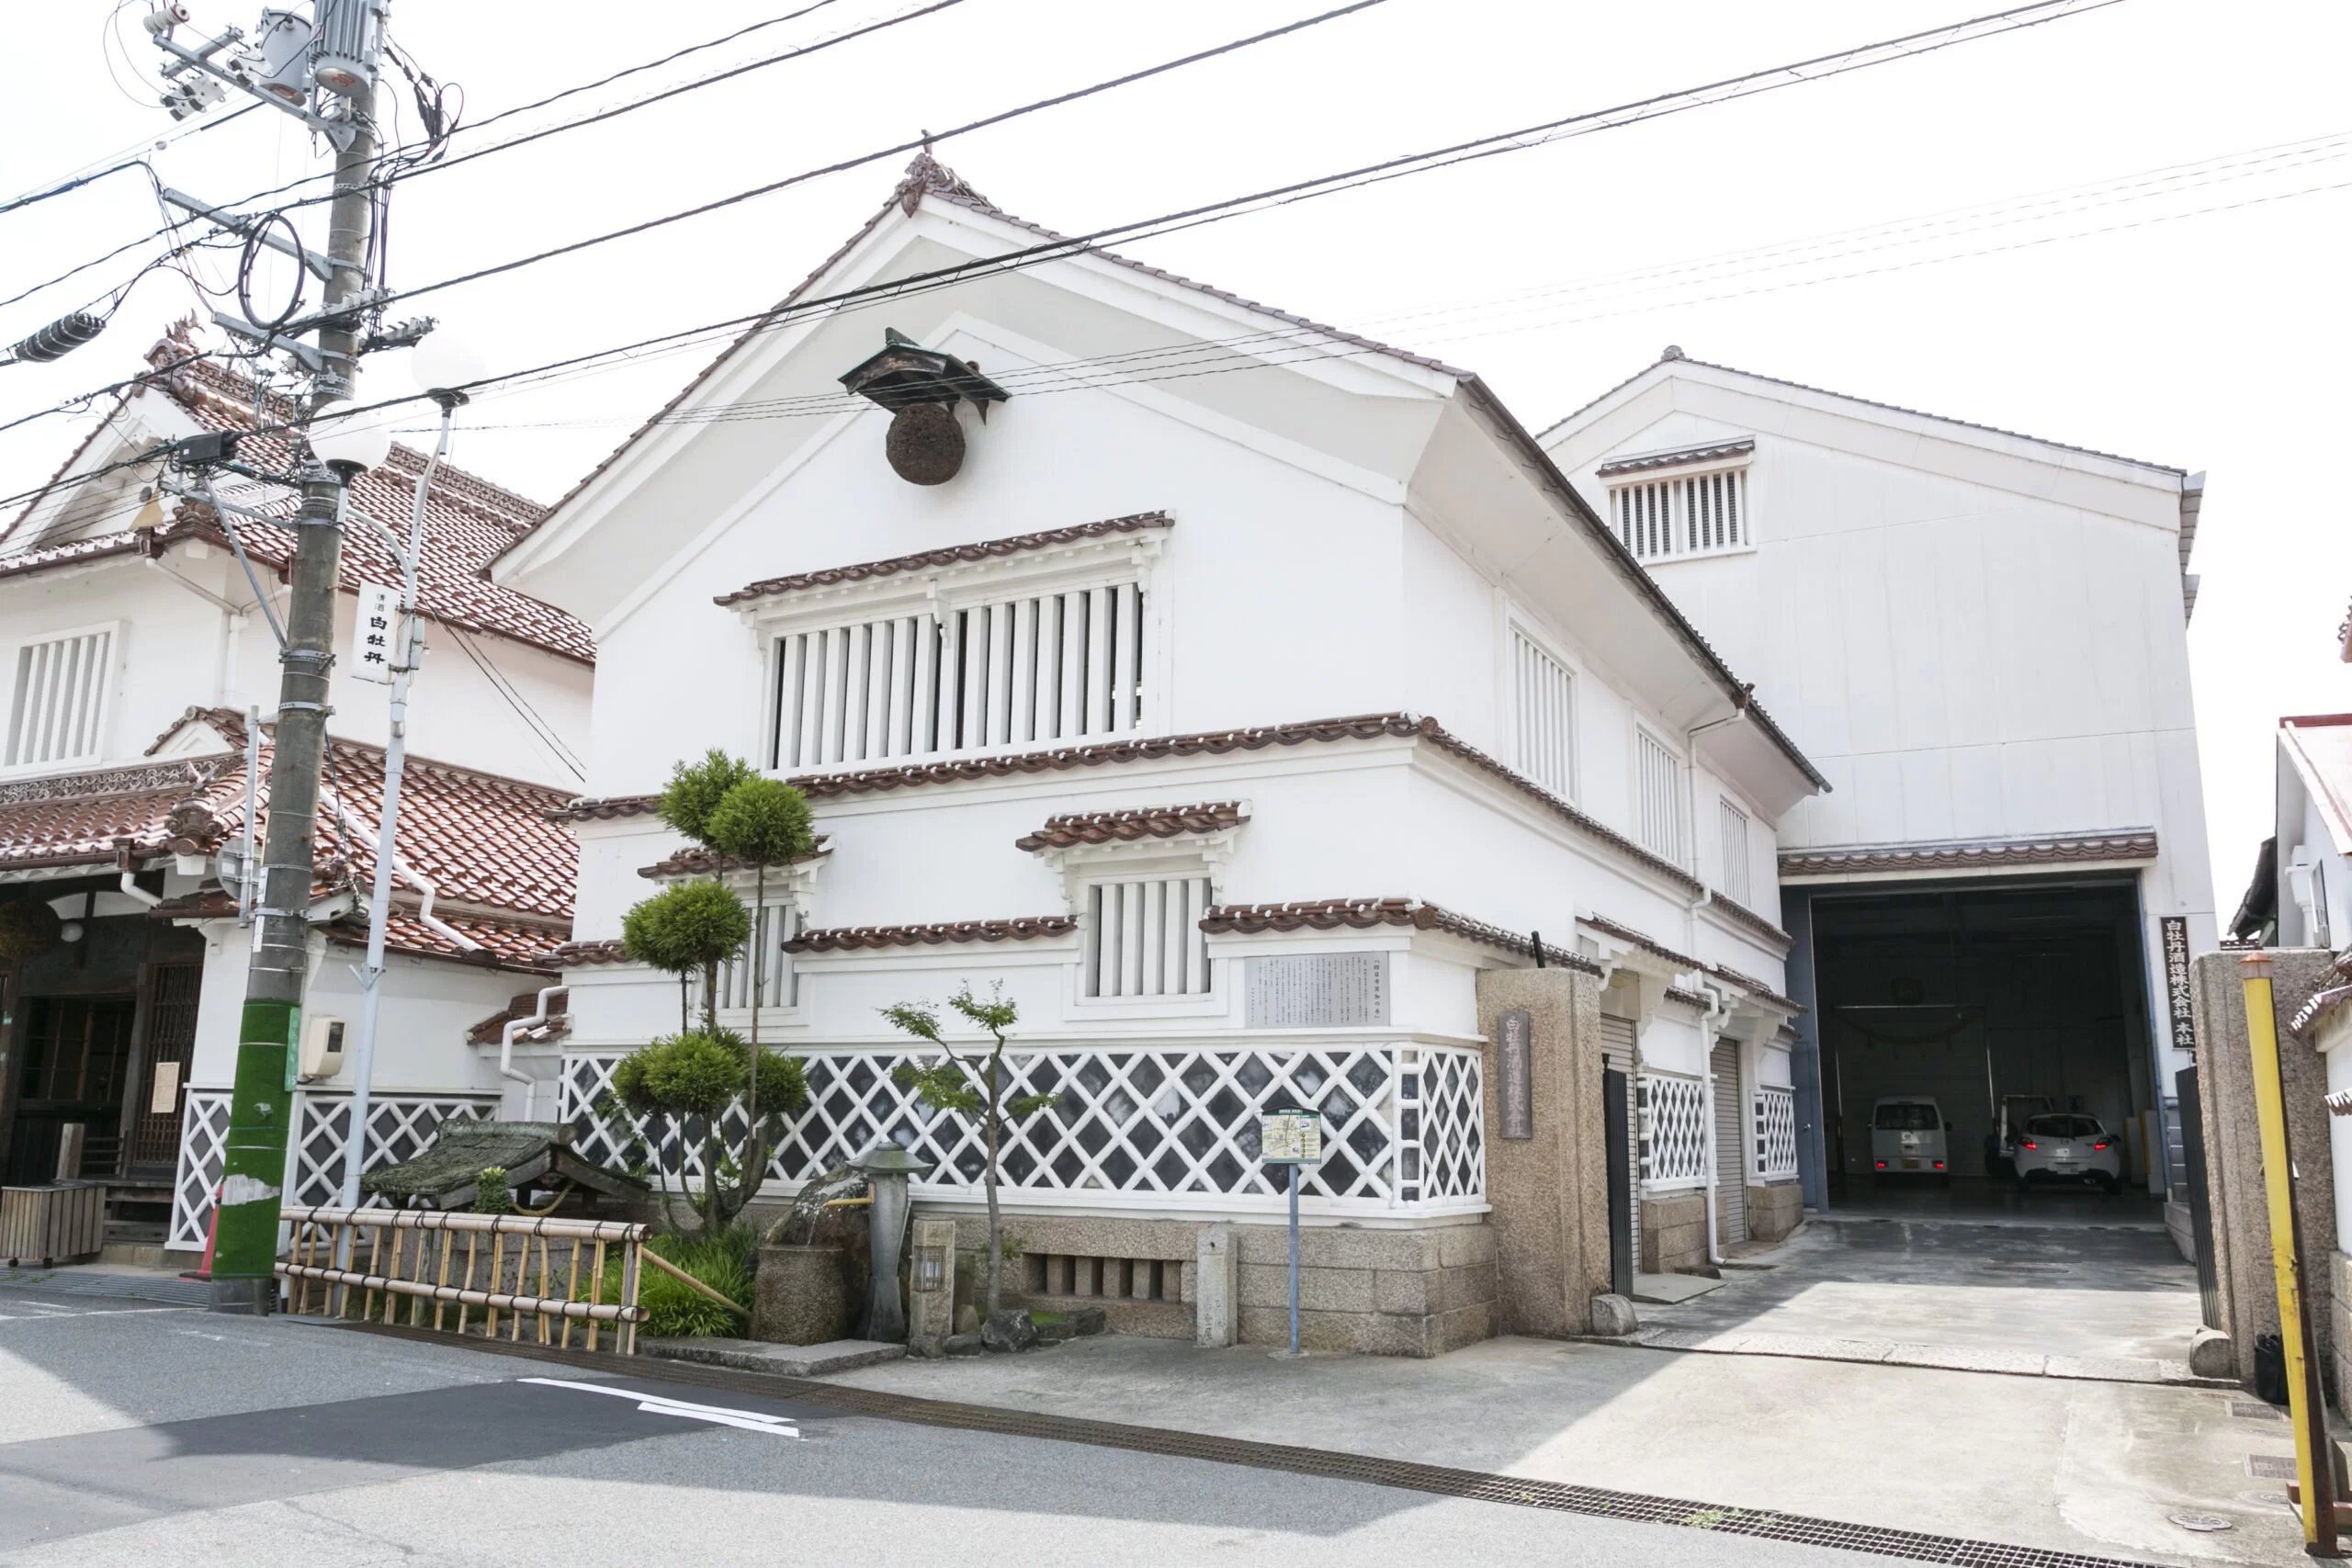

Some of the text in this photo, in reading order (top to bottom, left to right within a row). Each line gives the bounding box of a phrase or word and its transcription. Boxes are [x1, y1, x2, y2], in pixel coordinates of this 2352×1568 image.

[364, 616, 387, 664] 白牡丹
[2166, 919, 2194, 1046] 白牡丹酒造株式会社 本社
